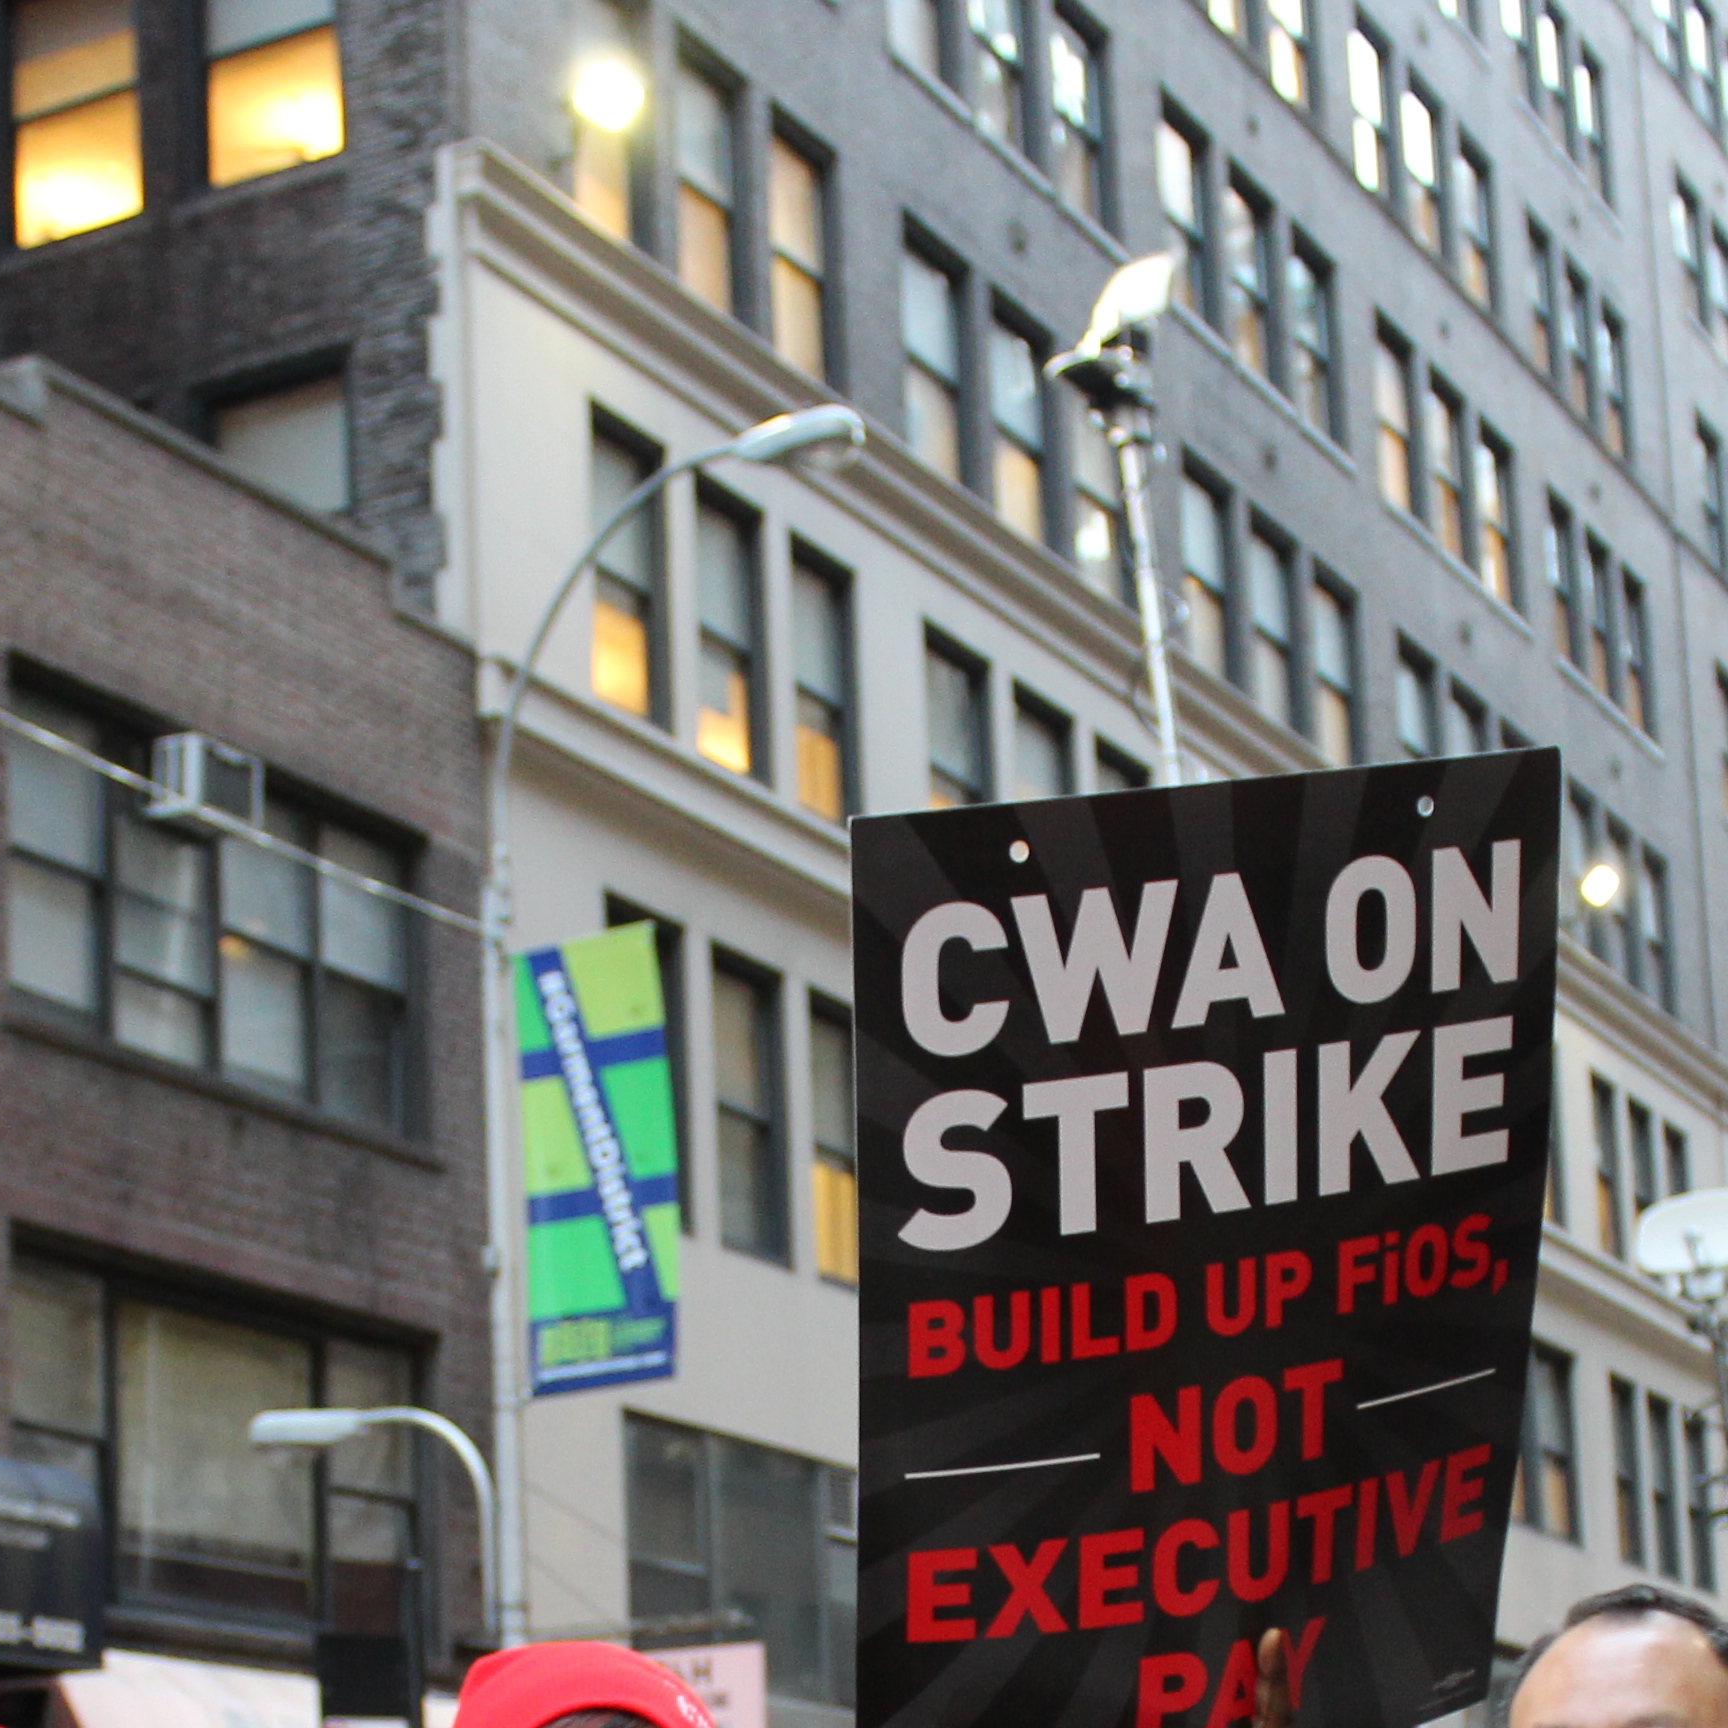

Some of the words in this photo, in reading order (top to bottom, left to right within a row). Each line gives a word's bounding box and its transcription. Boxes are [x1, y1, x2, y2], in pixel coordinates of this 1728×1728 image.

[901, 871, 1286, 1057] CWA
[1325, 838, 1522, 1004] ON
[896, 1014, 1514, 1252] STRIKE
[906, 1271, 1178, 1379] BUILD
[1204, 1250, 1313, 1338] UP
[1336, 1213, 1510, 1315] FiOS,
[1129, 1358, 1344, 1494] NOT
[905, 1443, 1493, 1644] EXECUTIVE
